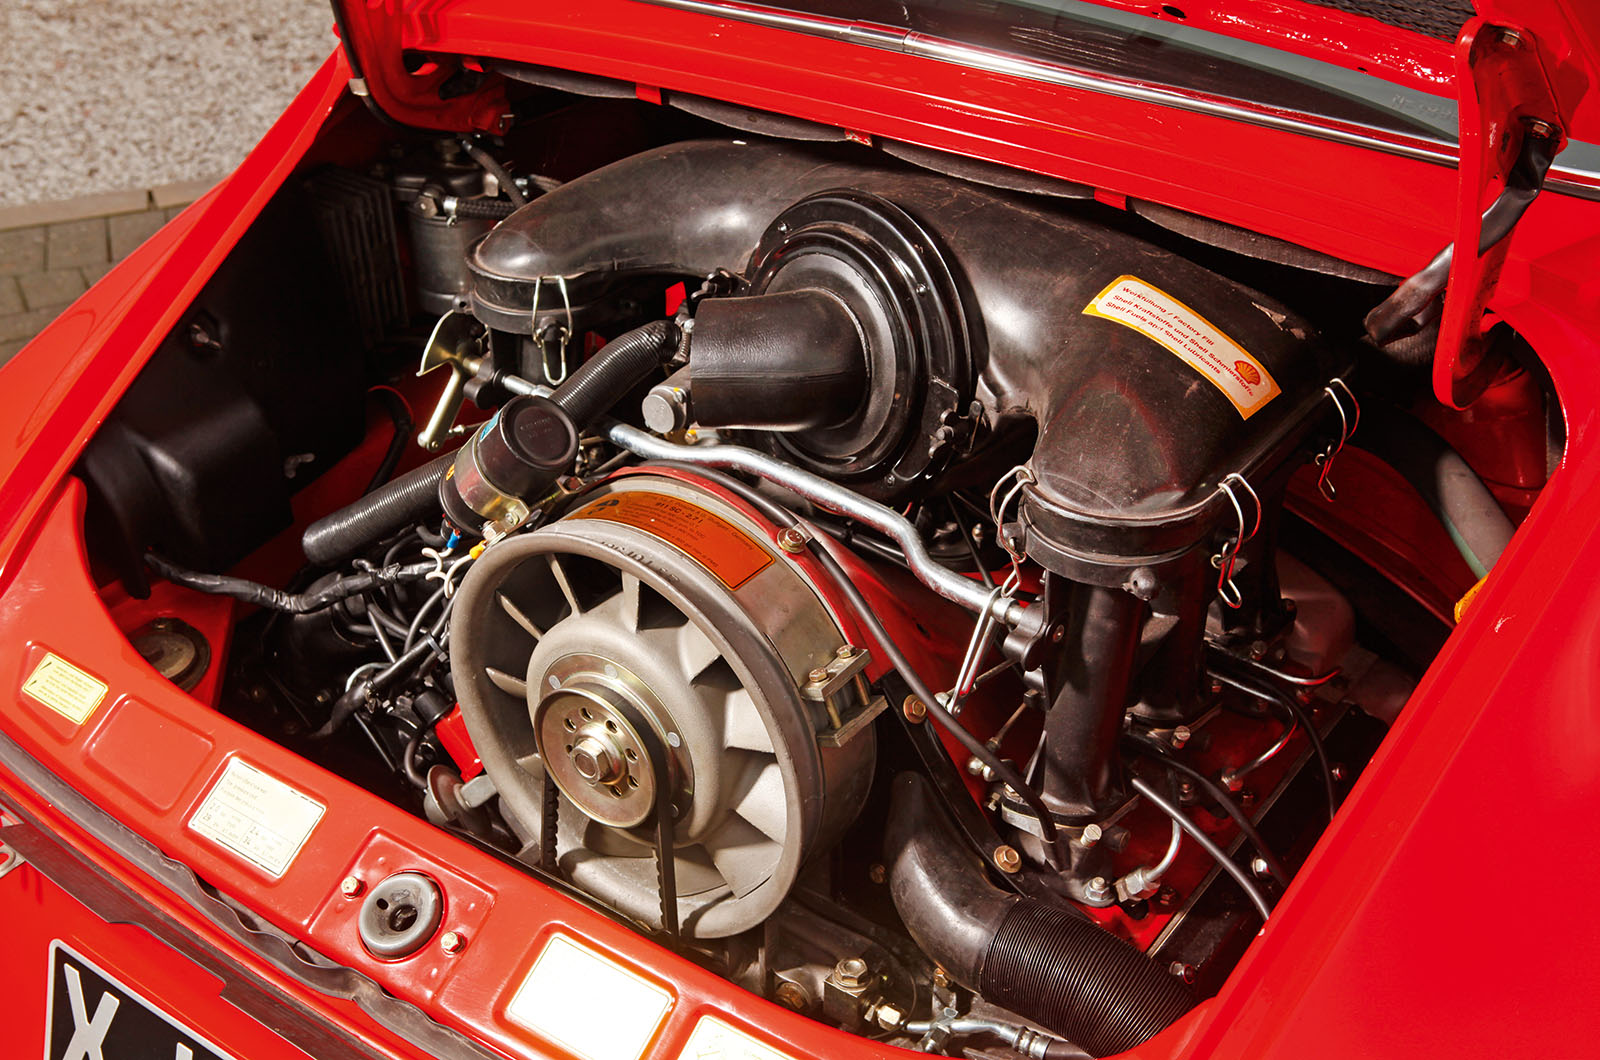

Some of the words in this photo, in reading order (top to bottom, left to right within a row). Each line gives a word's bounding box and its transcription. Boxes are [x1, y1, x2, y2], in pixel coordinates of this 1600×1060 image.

[1105, 301, 1126, 312] Shell
[1126, 309, 1147, 322] Fuels
[1164, 330, 1184, 345] Shell
[1183, 343, 1221, 374] Lubricants
[1113, 295, 1133, 306] Shell
[1133, 303, 1174, 328] Kraftstoffe
[1174, 327, 1189, 339] und
[1189, 338, 1209, 354] Shell
[1173, 315, 1201, 336] Factory
[1201, 335, 1215, 346] Fill
